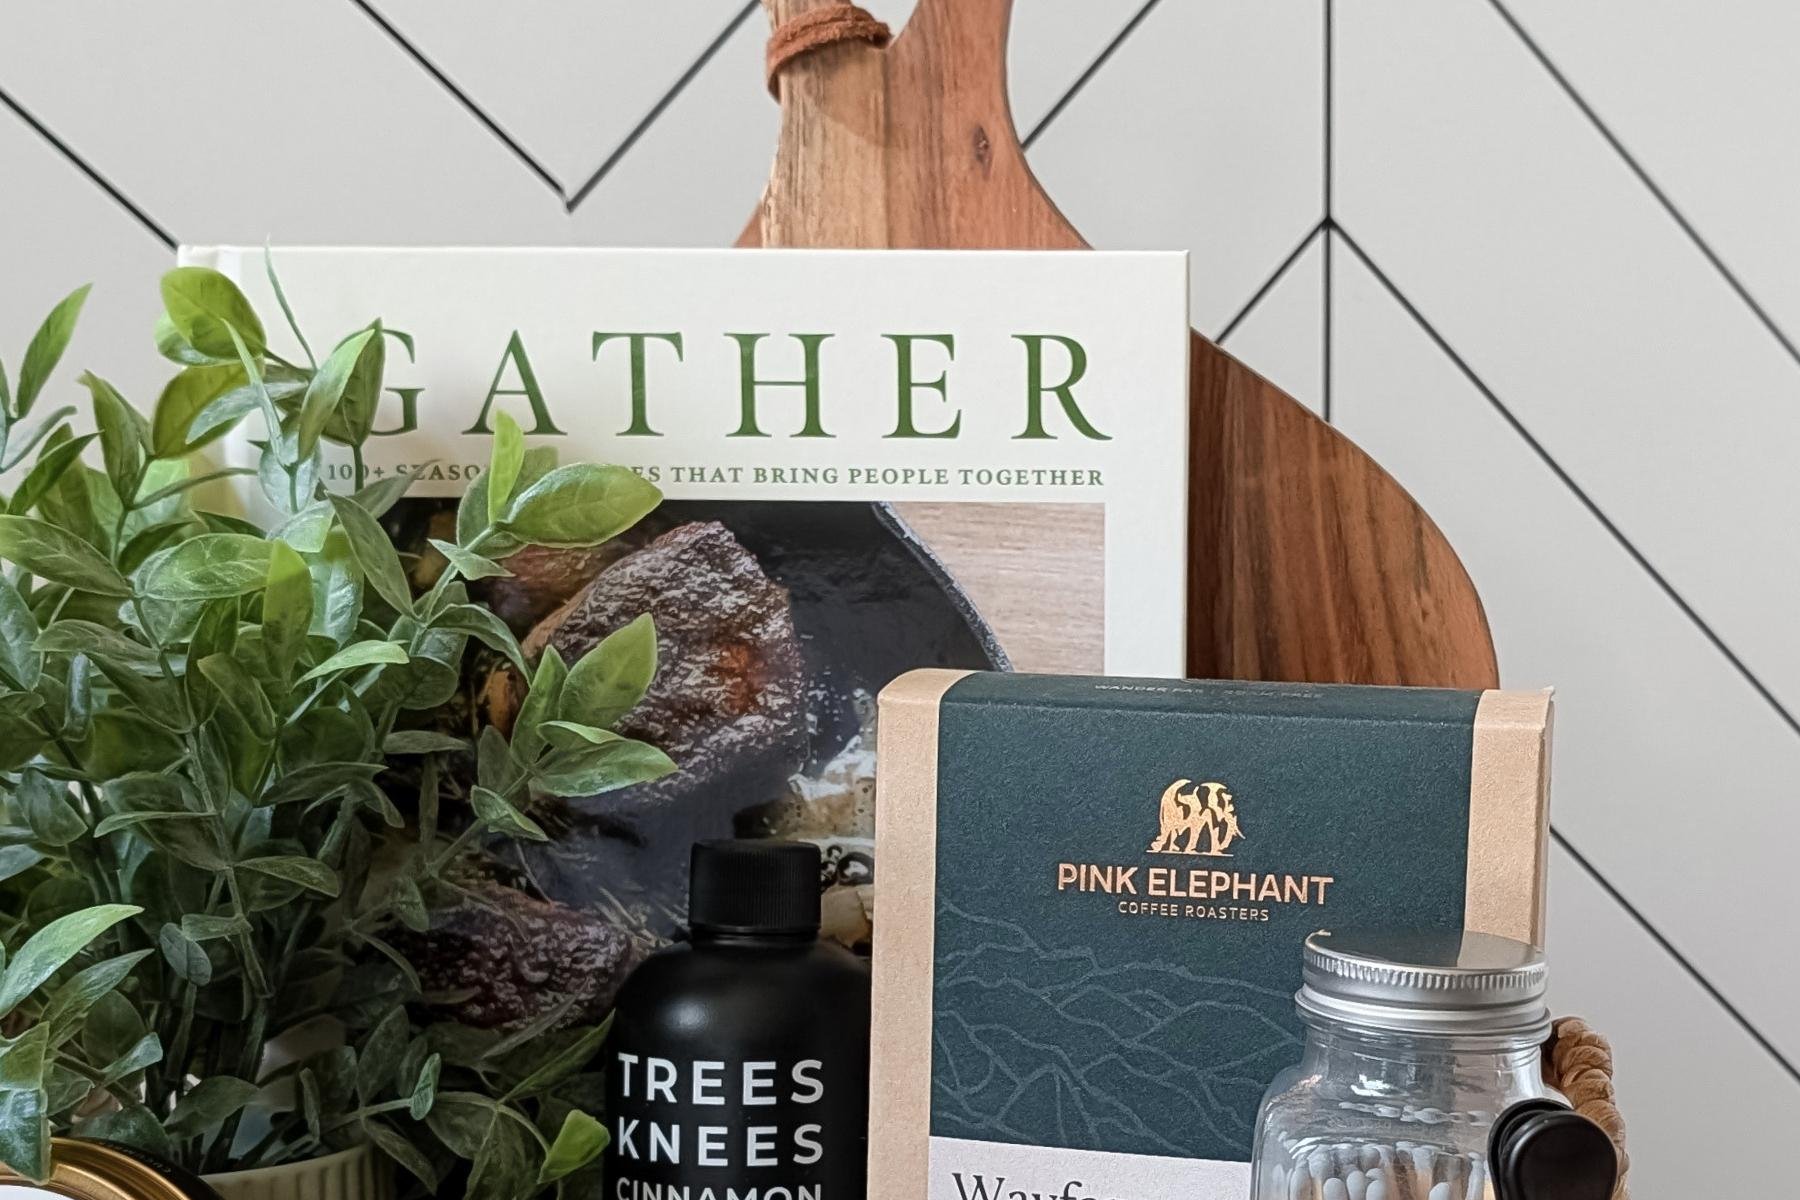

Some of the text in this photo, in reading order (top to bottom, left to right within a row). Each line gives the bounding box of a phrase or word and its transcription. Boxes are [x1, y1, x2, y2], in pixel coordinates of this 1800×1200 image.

[332, 328, 1113, 441] GATHER
[396, 464, 486, 481] SEASO
[671, 466, 743, 483] THAT
[754, 466, 839, 485] BRING
[848, 468, 949, 486] PEOPLE
[959, 469, 1105, 487] TOGETHER
[1057, 862, 1335, 905] PINK ELEPHANT
[1117, 900, 1270, 922] COFFEE ROASTERS
[617, 1052, 824, 1106] TREES
[617, 1115, 824, 1168] KNEES
